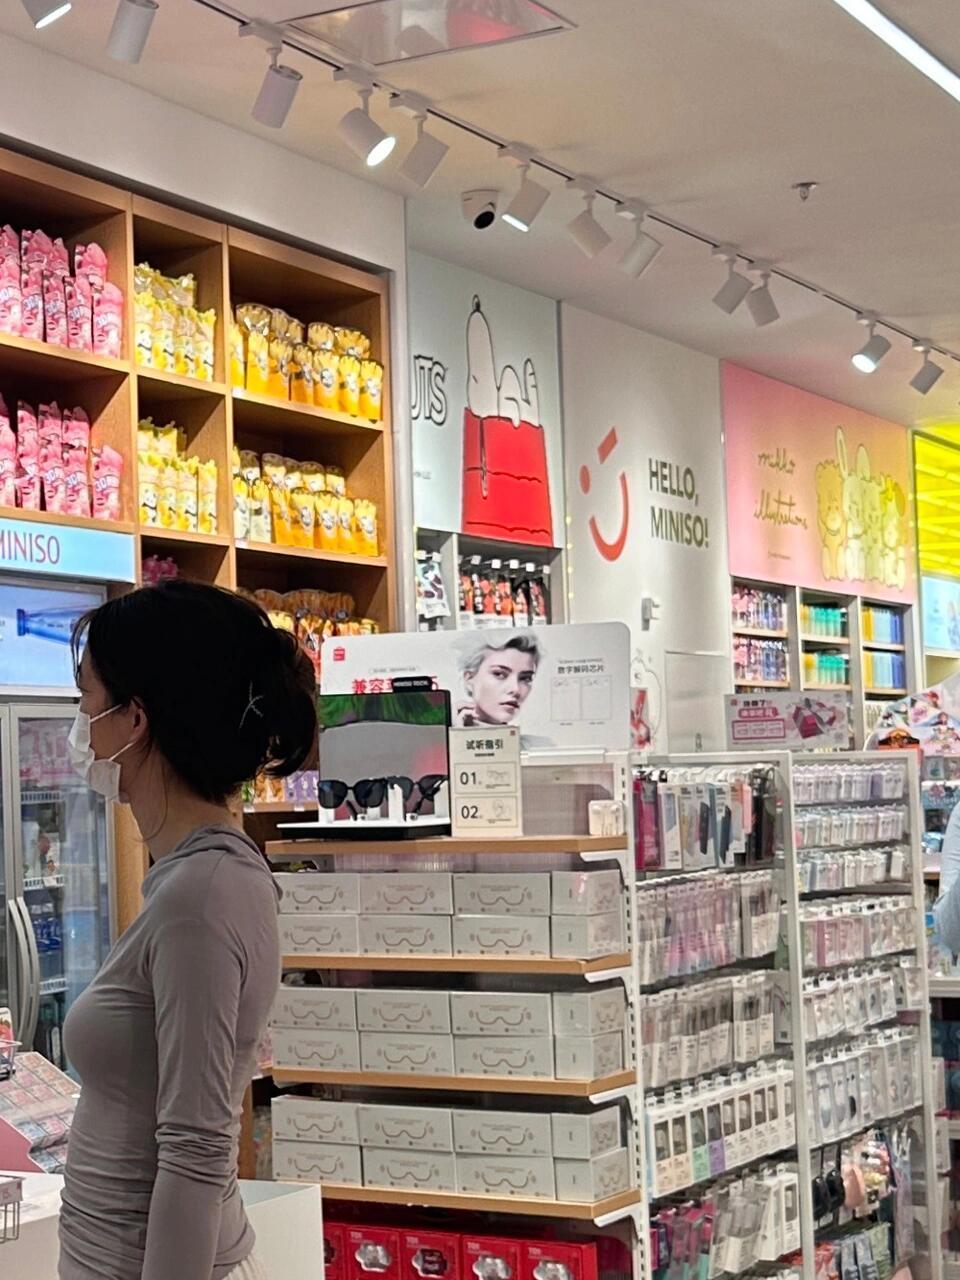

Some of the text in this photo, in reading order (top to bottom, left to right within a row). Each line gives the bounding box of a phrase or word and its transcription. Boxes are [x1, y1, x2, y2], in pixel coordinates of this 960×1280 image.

[649, 458, 698, 506] HELLO,
[650, 506, 709, 548] MINISO!
[466, 739, 503, 750] 试听指引
